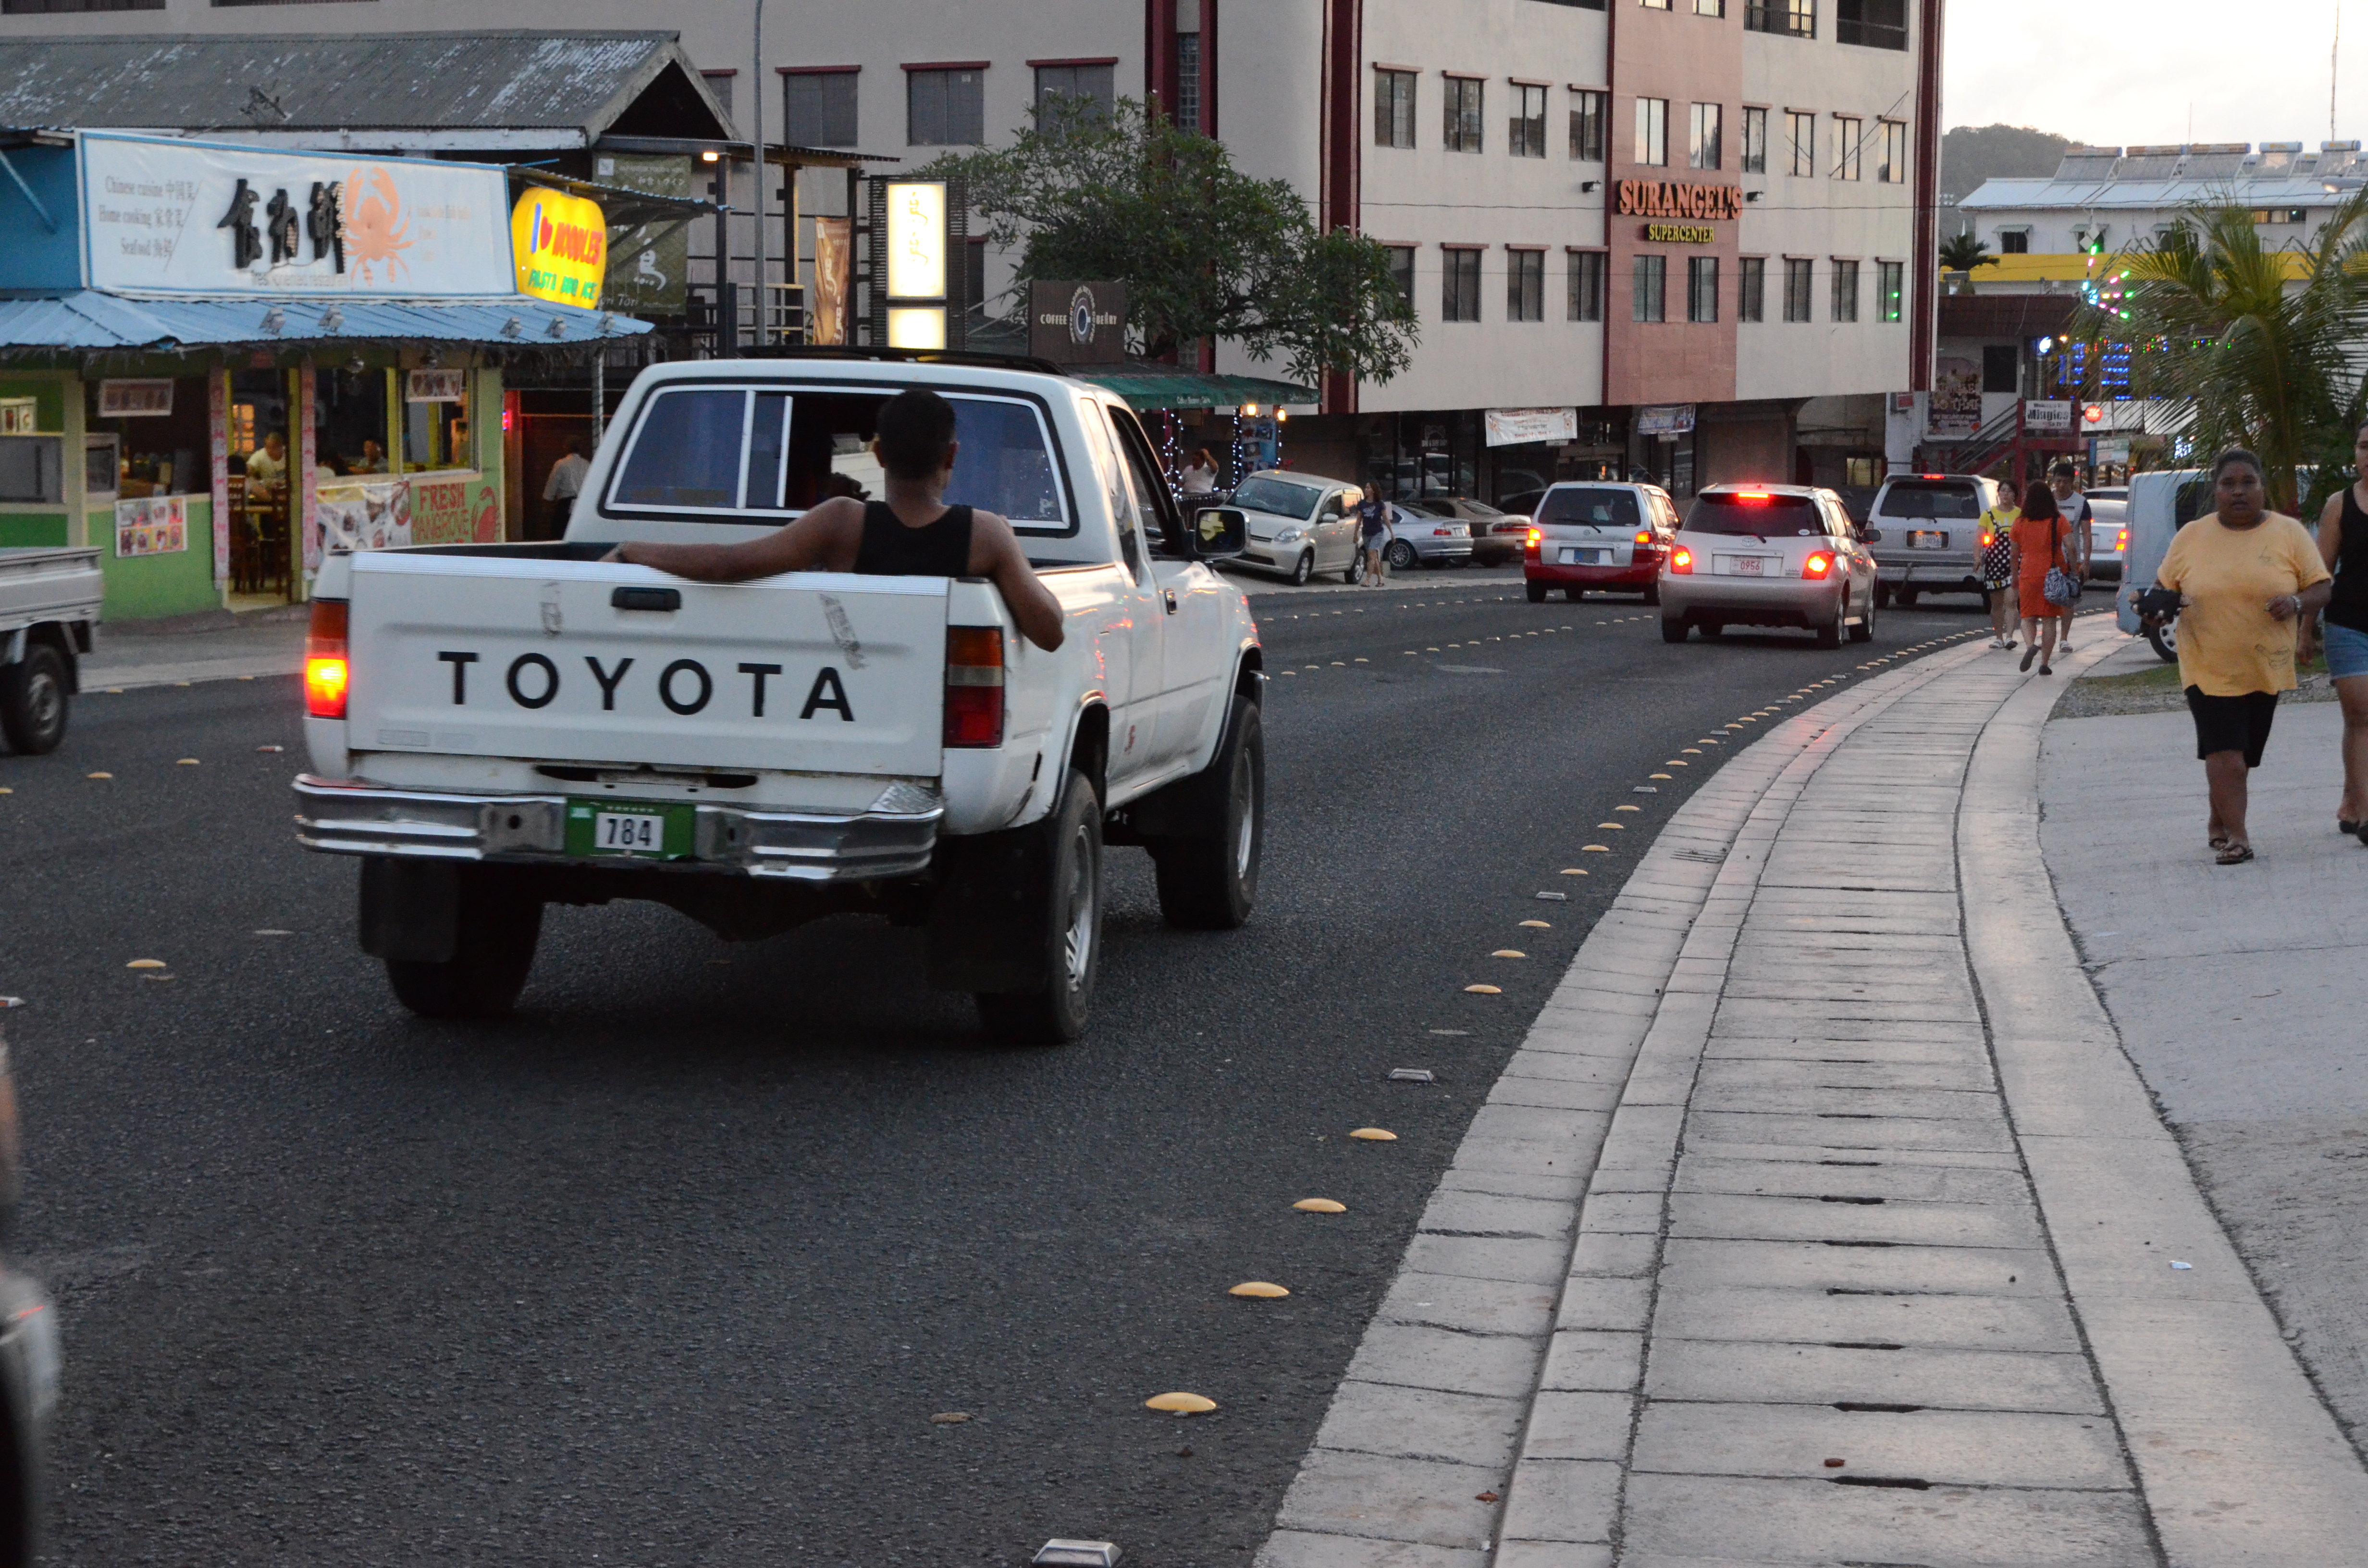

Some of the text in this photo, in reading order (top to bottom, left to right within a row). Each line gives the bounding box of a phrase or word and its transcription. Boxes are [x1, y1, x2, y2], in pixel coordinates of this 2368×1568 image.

[1619, 180, 1743, 220] SURANGEL'S
[1649, 223, 1714, 243] SUPERCENTER
[1040, 313, 1068, 325] COFFEE
[419, 482, 466, 512] FRESH
[1740, 561, 1760, 570] 0956
[438, 651, 855, 722] TOYOTA
[607, 818, 653, 846] 784
